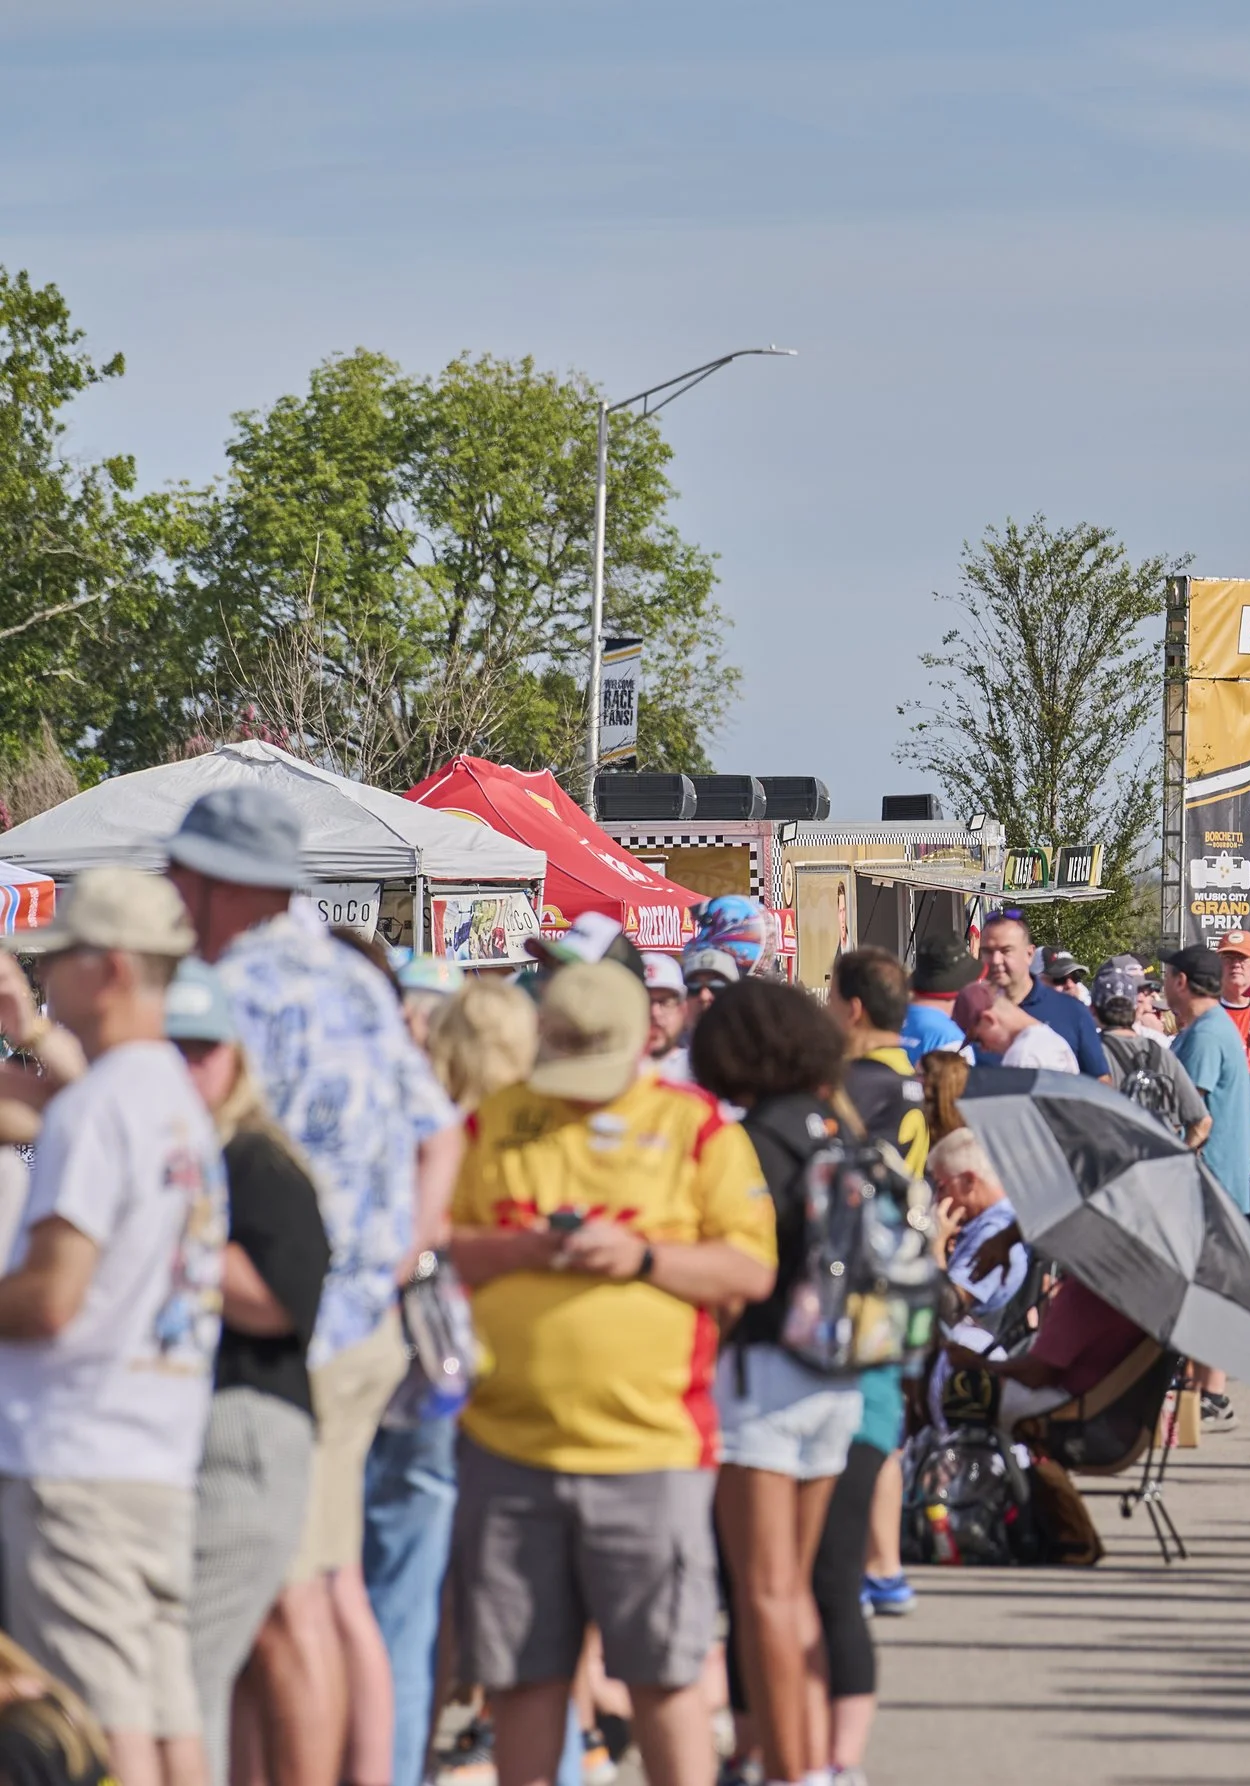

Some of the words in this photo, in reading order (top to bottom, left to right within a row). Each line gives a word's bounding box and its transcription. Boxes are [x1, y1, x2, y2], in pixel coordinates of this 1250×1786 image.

[604, 679, 634, 690] WELCOME
[604, 690, 634, 709] RACE
[603, 710, 633, 727] FANS!
[1205, 831, 1244, 843] BORCHETTA
[1194, 892, 1228, 902] MUSIC
[1228, 893, 1248, 902] CITY
[318, 900, 370, 922] SoCo
[1191, 901, 1250, 915] GRAND
[1201, 915, 1243, 929] PRIX
